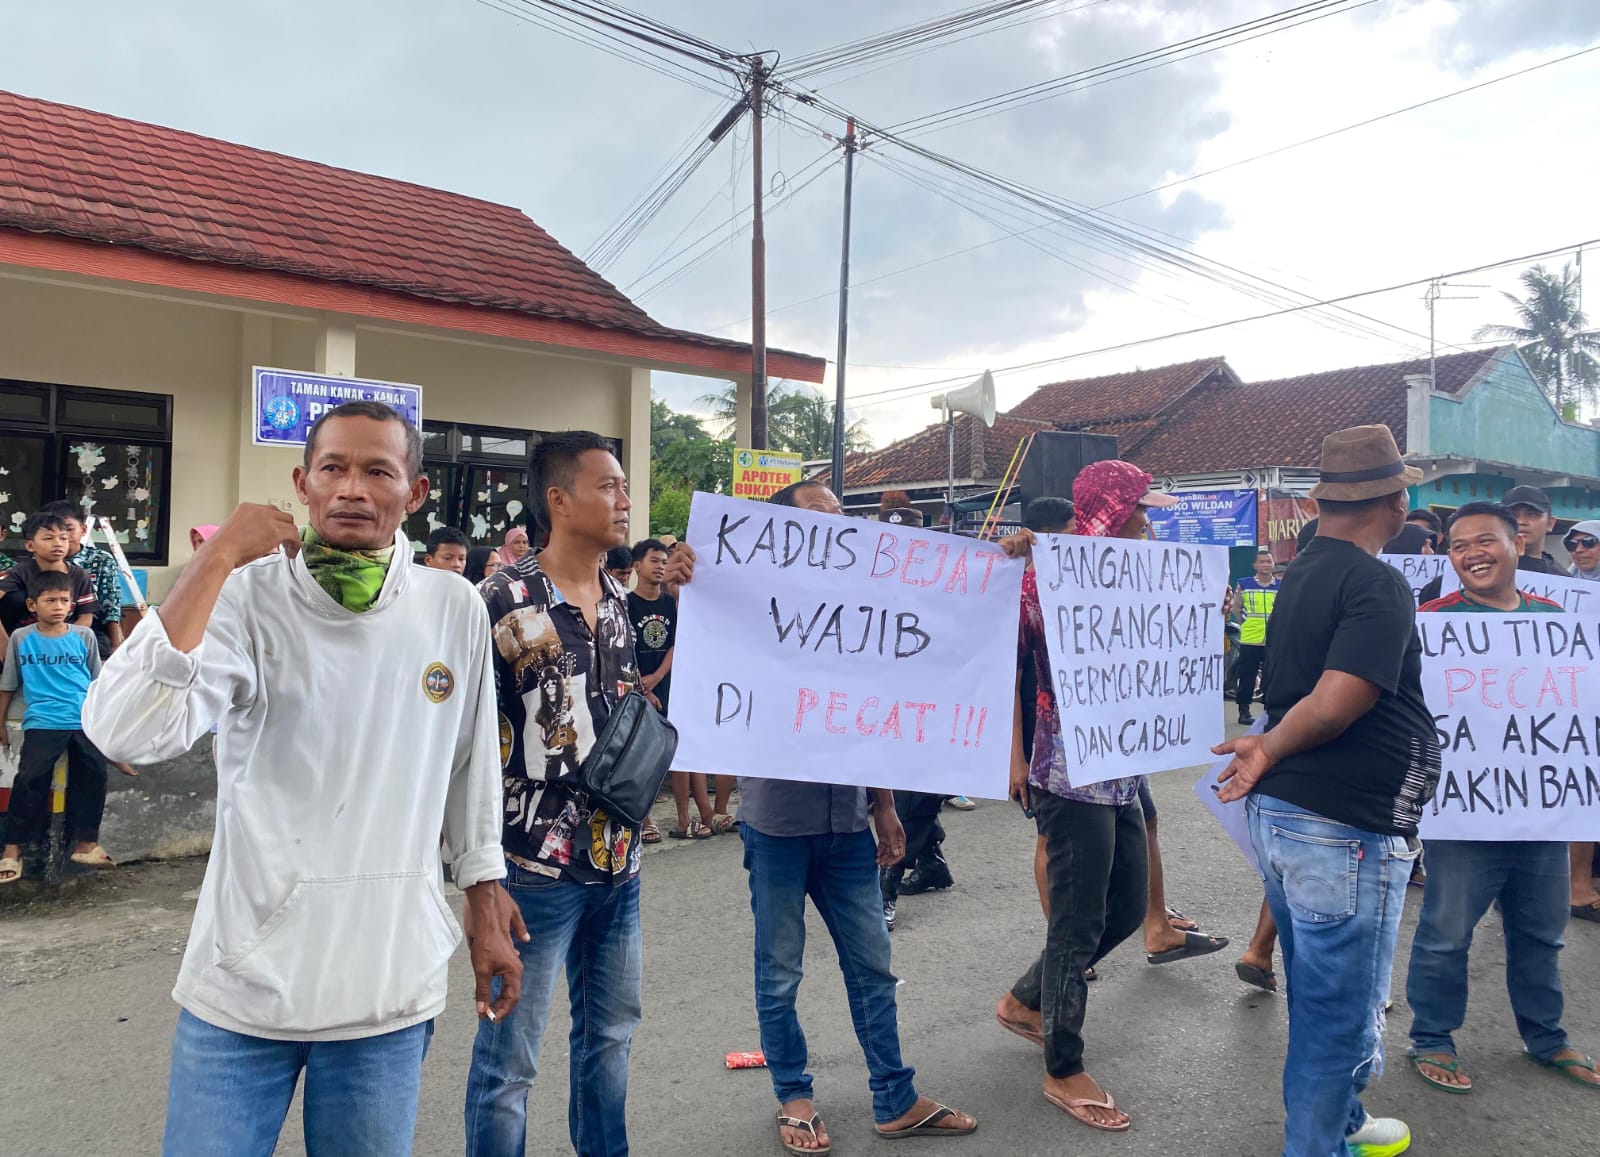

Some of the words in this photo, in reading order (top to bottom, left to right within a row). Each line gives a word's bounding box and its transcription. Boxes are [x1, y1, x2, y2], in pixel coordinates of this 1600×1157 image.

[291, 382, 327, 397] TAMAN
[330, 387, 364, 401] KANAK
[374, 391, 407, 405] KANAK
[741, 470, 791, 484] APOTEK
[1191, 501, 1233, 510] WILDAN
[716, 514, 857, 570] KADUS
[870, 531, 1003, 595] BEJAT
[1049, 542, 1153, 592] JANGAN
[1159, 548, 1207, 594] ADA
[770, 597, 931, 659] WAJIB
[1057, 602, 1216, 654] PERANGKAT
[1503, 619, 1600, 660] TIDA
[36, 653, 86, 666] Hurley
[1058, 659, 1175, 709] BERMORAL
[1178, 653, 1223, 696] BEJAT
[1444, 666, 1588, 708] PECAT
[716, 682, 752, 729] DI
[793, 687, 937, 744] PECAT
[1503, 712, 1600, 756] AKA
[1074, 724, 1113, 769] DAN
[1118, 713, 1191, 756] CABUL
